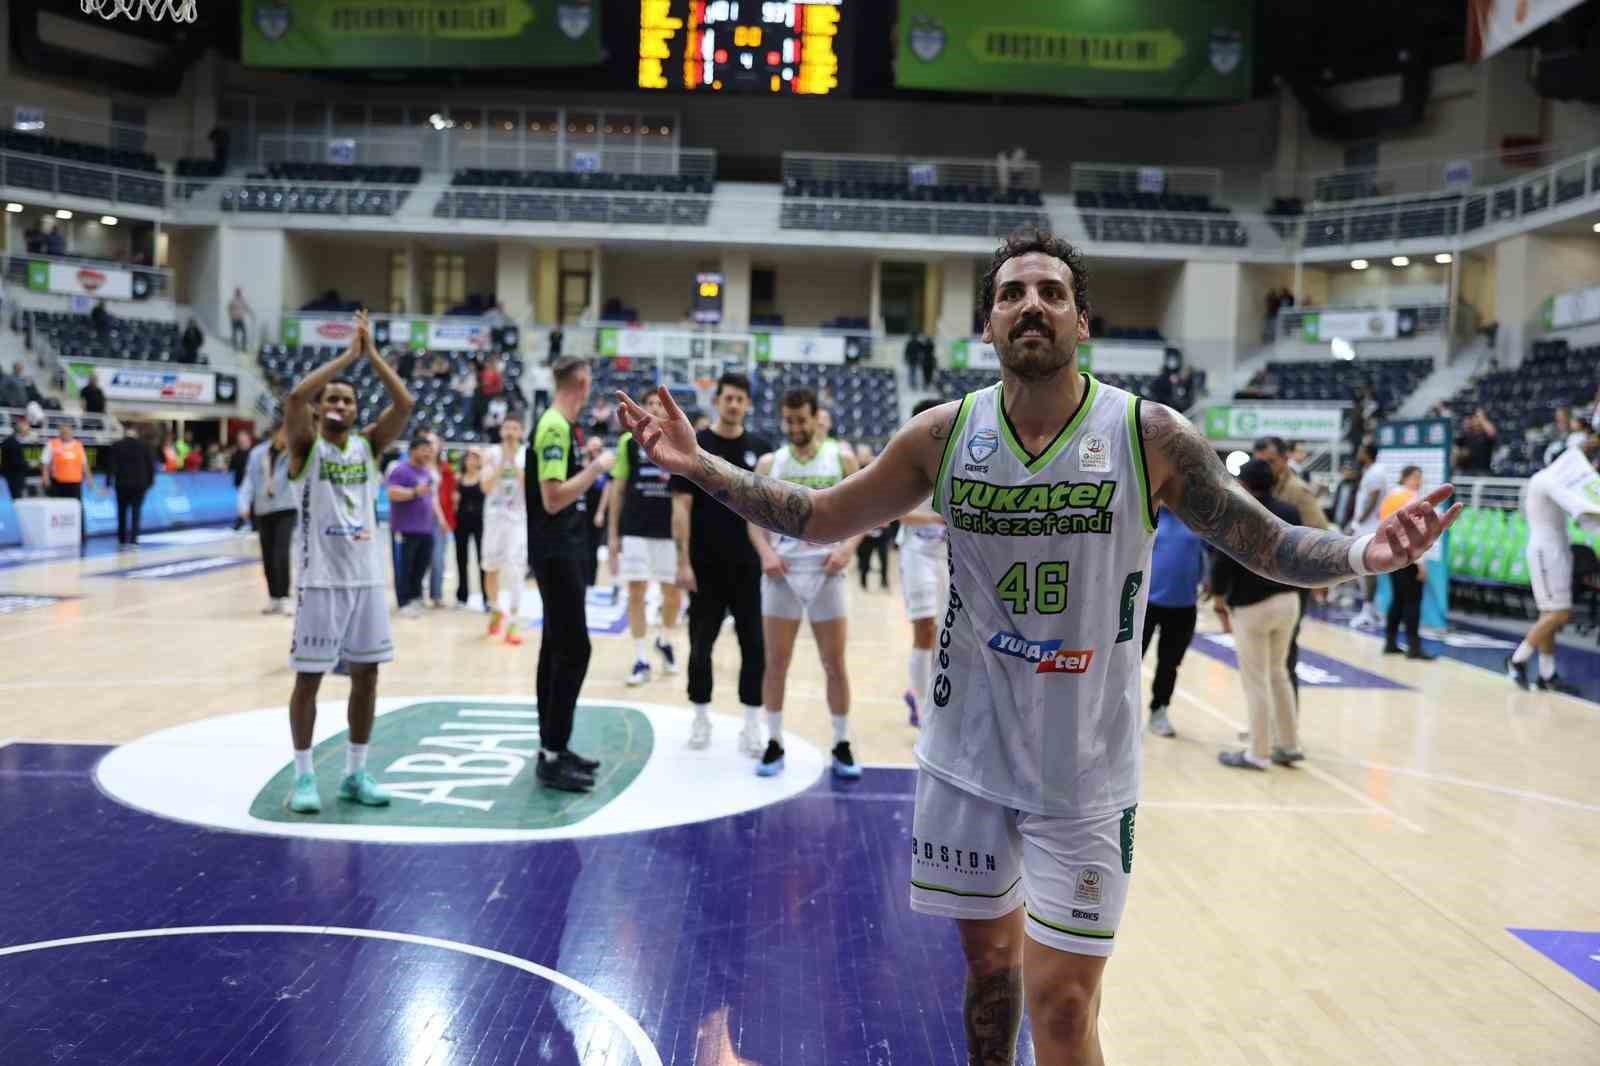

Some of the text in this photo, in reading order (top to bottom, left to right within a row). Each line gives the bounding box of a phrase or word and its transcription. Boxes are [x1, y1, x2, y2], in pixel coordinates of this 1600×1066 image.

[950, 507, 1114, 536] Merkezefendi
[996, 561, 1070, 615] 46
[912, 838, 996, 871] BOSTON
